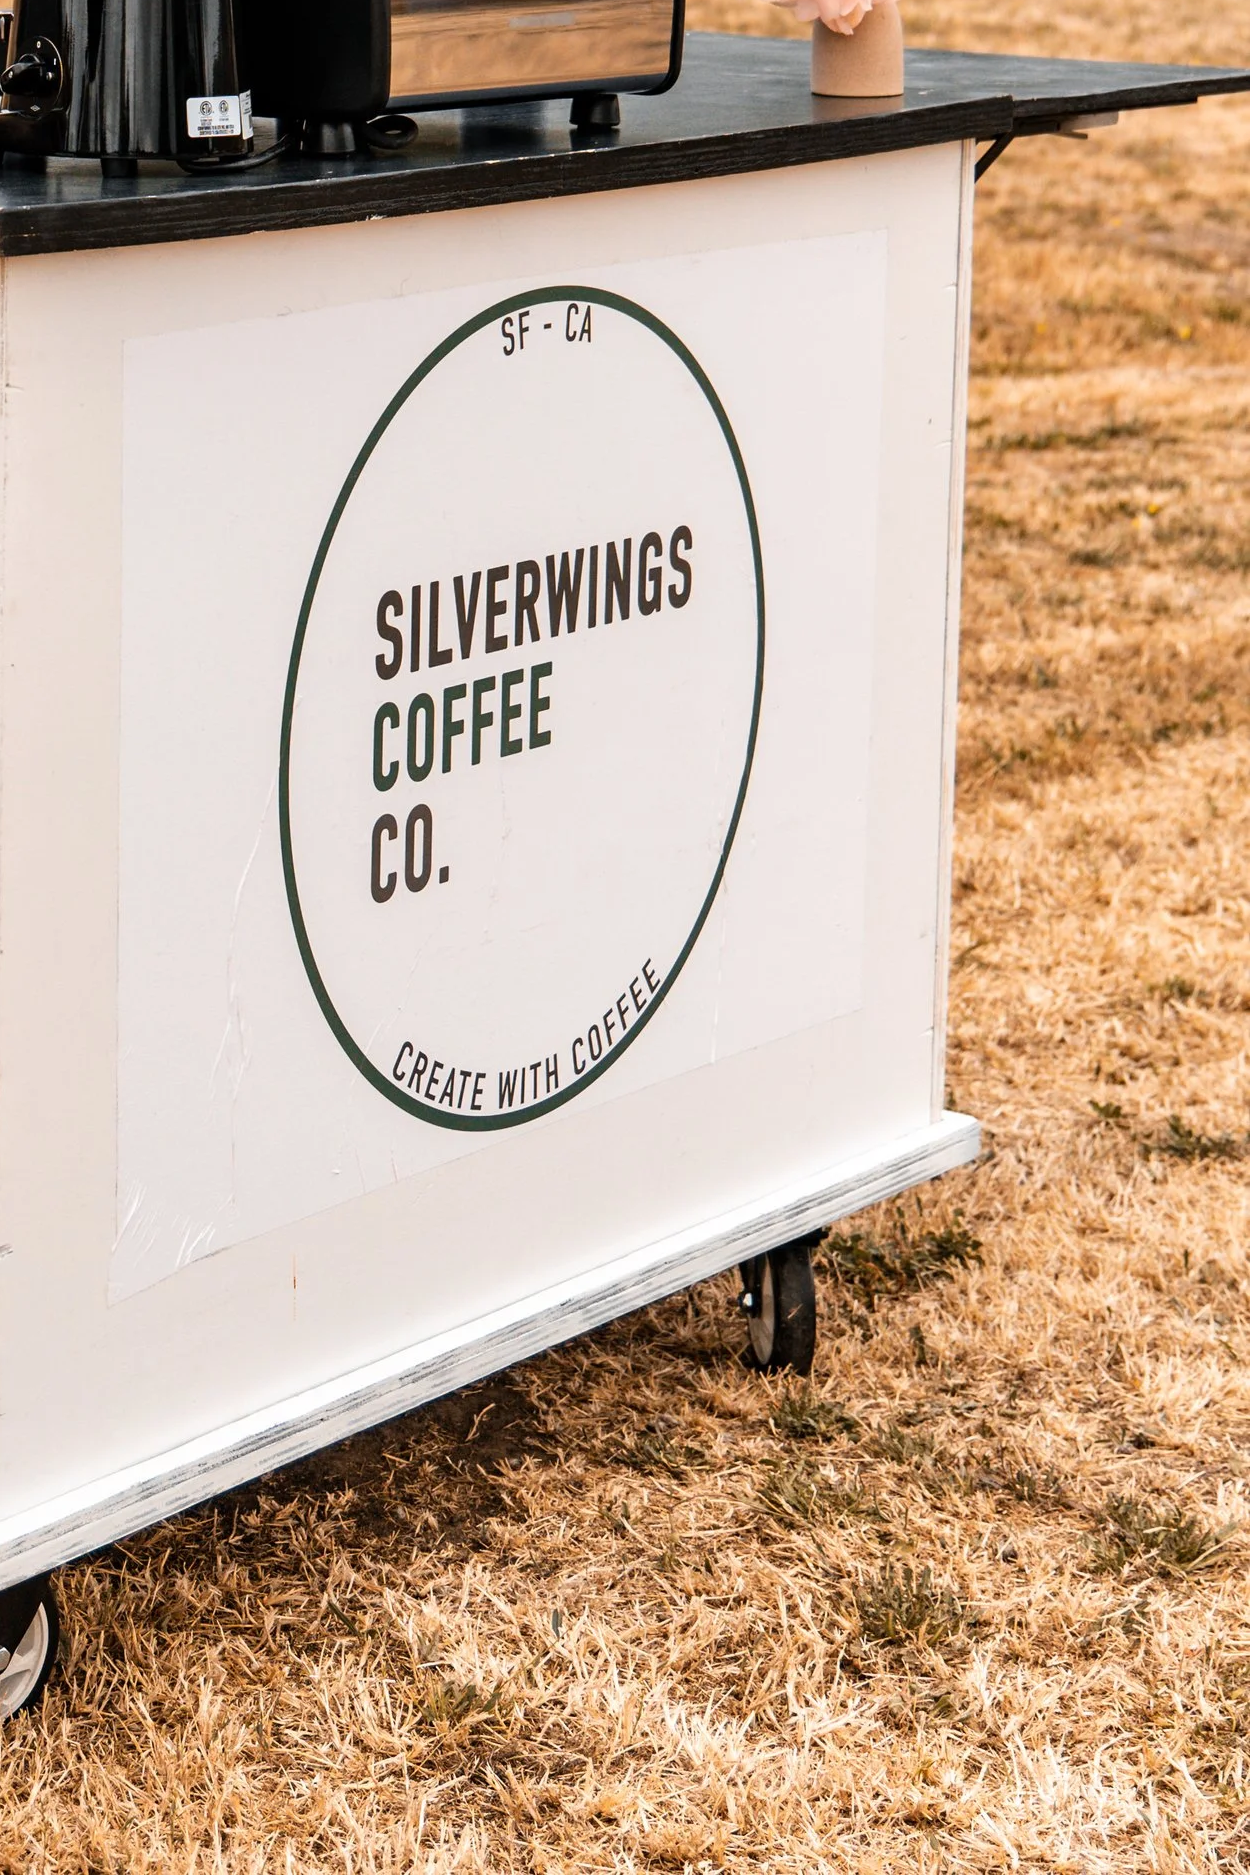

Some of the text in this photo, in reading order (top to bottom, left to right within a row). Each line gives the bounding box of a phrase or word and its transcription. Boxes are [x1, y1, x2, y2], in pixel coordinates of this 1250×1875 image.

[501, 310, 530, 356] SF
[565, 303, 591, 343] CA
[375, 525, 693, 680] SILVERWINGS
[373, 661, 552, 792] COFFEE
[370, 803, 450, 903] CO.
[392, 958, 661, 1111] CREATE WITH COFFEE
